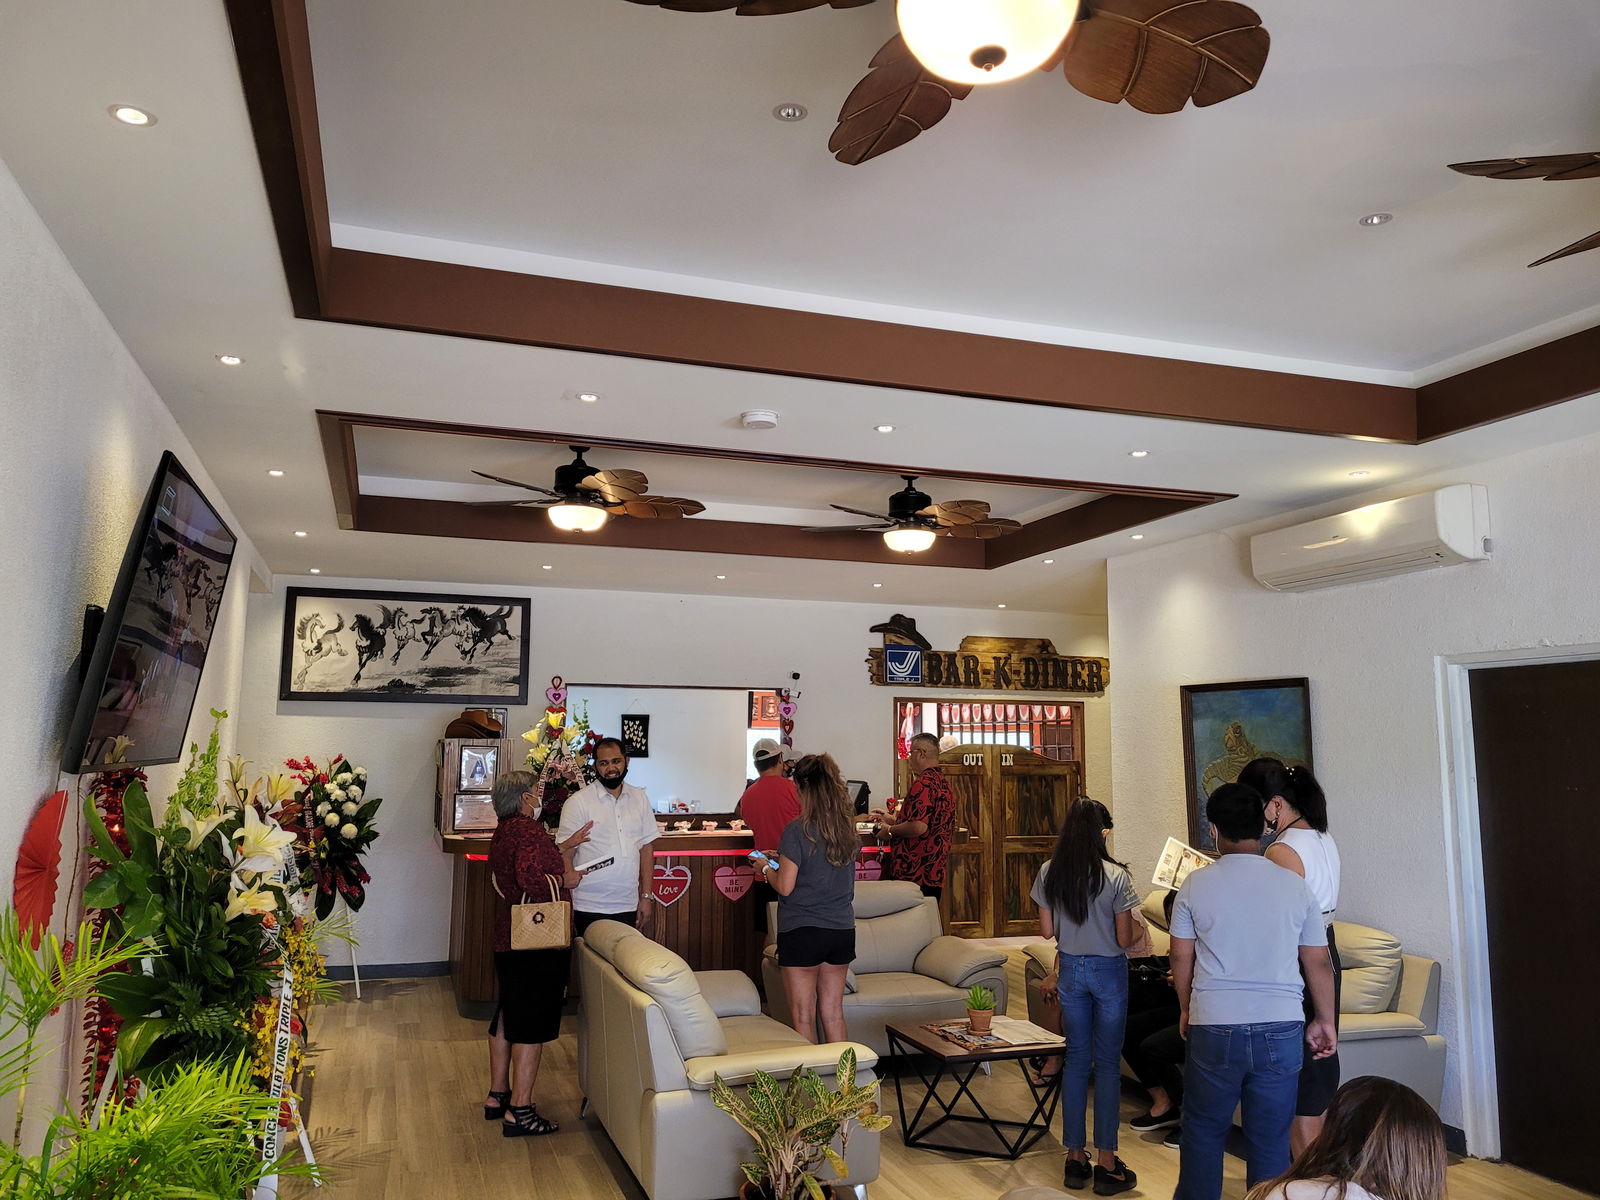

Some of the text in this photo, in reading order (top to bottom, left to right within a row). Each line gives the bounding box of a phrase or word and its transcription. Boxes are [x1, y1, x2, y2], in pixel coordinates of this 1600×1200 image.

[963, 753, 984, 766] OUT
[1001, 753, 1014, 766] IN
[658, 884, 679, 896] Love
[724, 885, 744, 893] MINE
[264, 1036, 289, 1159] CONGRAULATIONS
[279, 993, 292, 1035] TRIPLE
